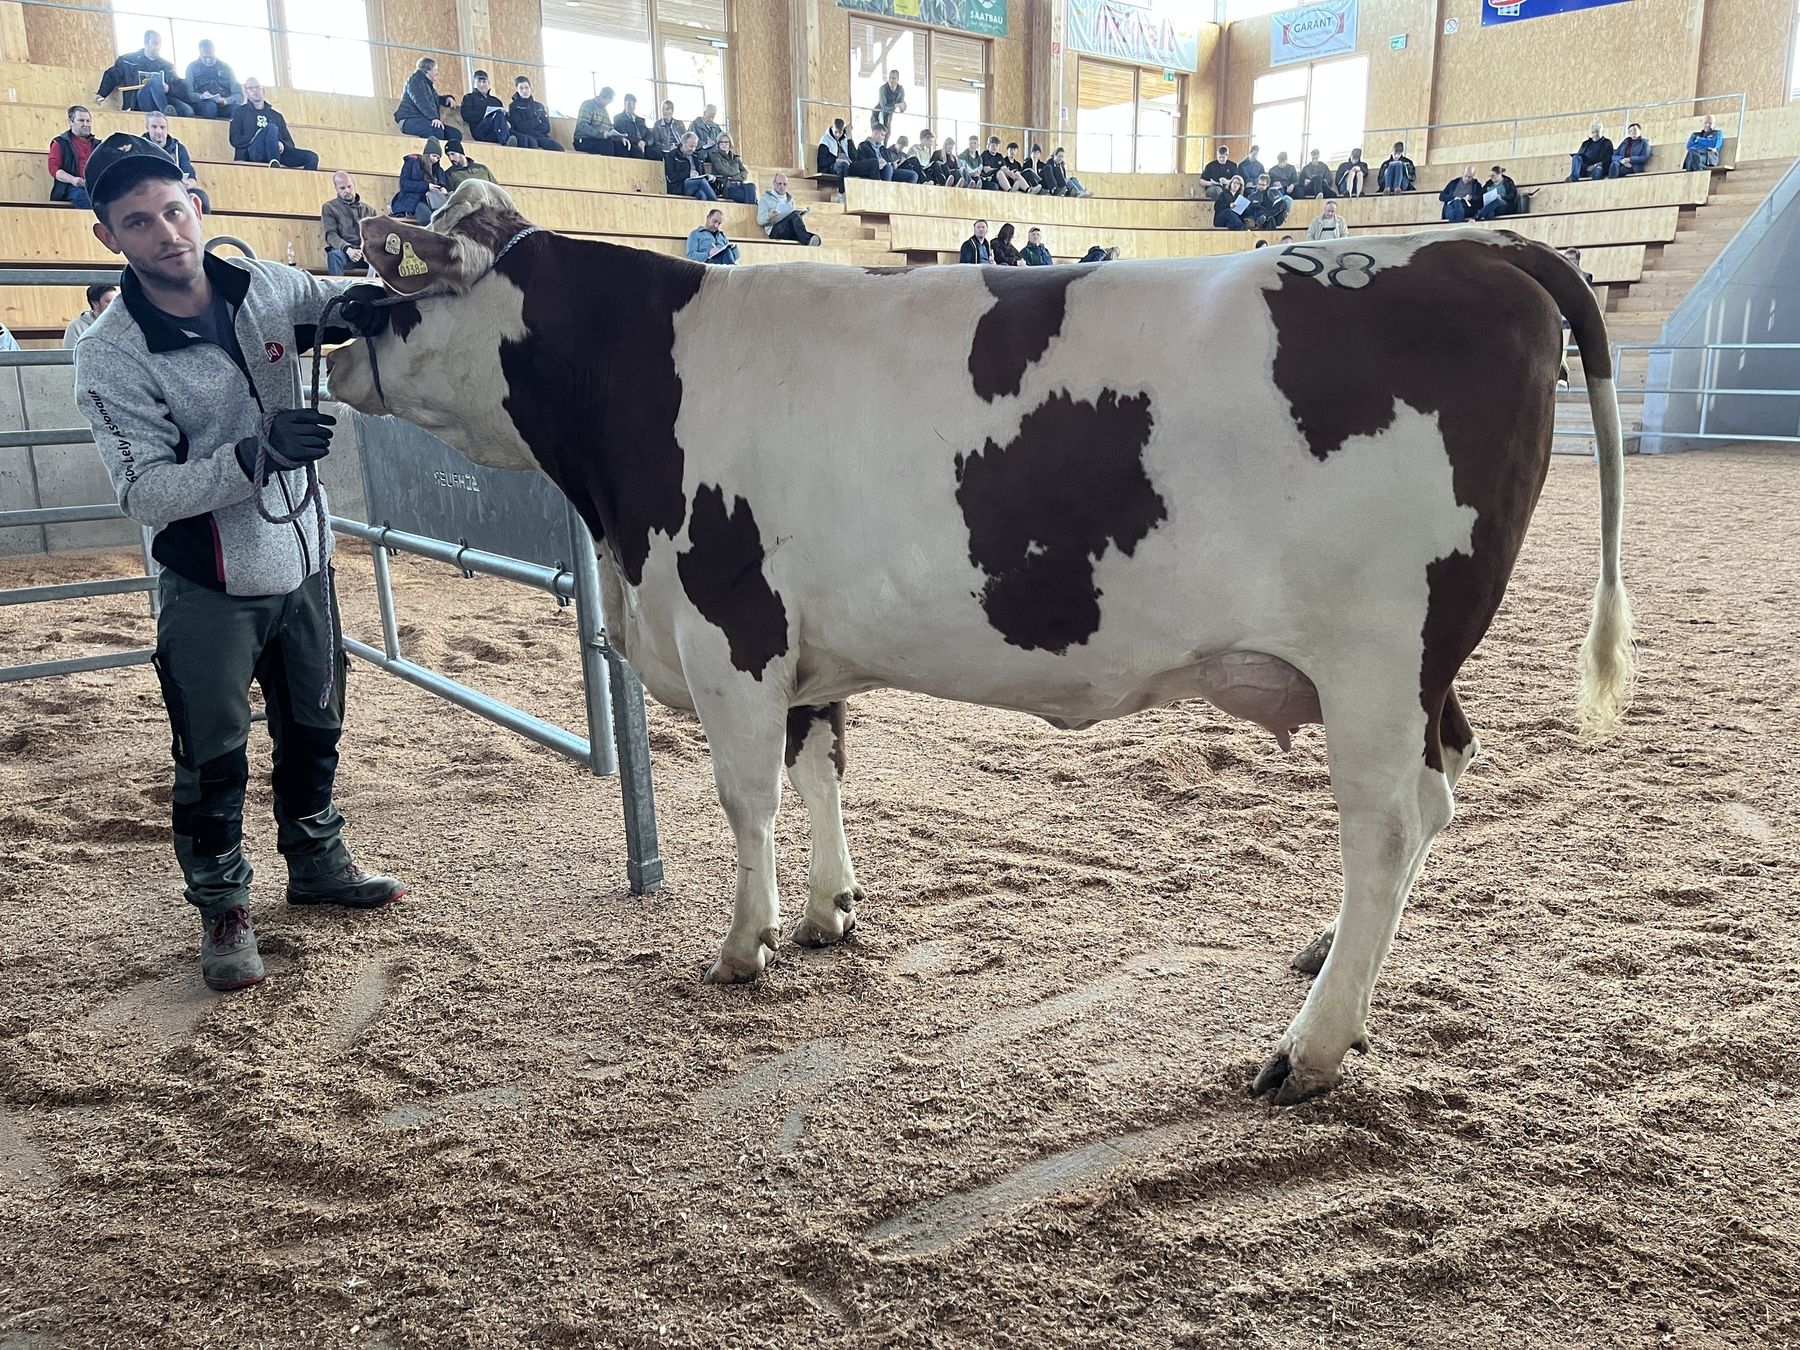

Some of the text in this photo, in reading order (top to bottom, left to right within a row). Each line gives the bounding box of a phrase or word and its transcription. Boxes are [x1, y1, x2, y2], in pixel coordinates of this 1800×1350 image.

[970, 11, 1003, 24] SAATBAU
[1294, 17, 1333, 32] GARANT
[400, 263, 420, 276] 0138
[1277, 245, 1375, 290] 58
[118, 439, 134, 463] Lely
